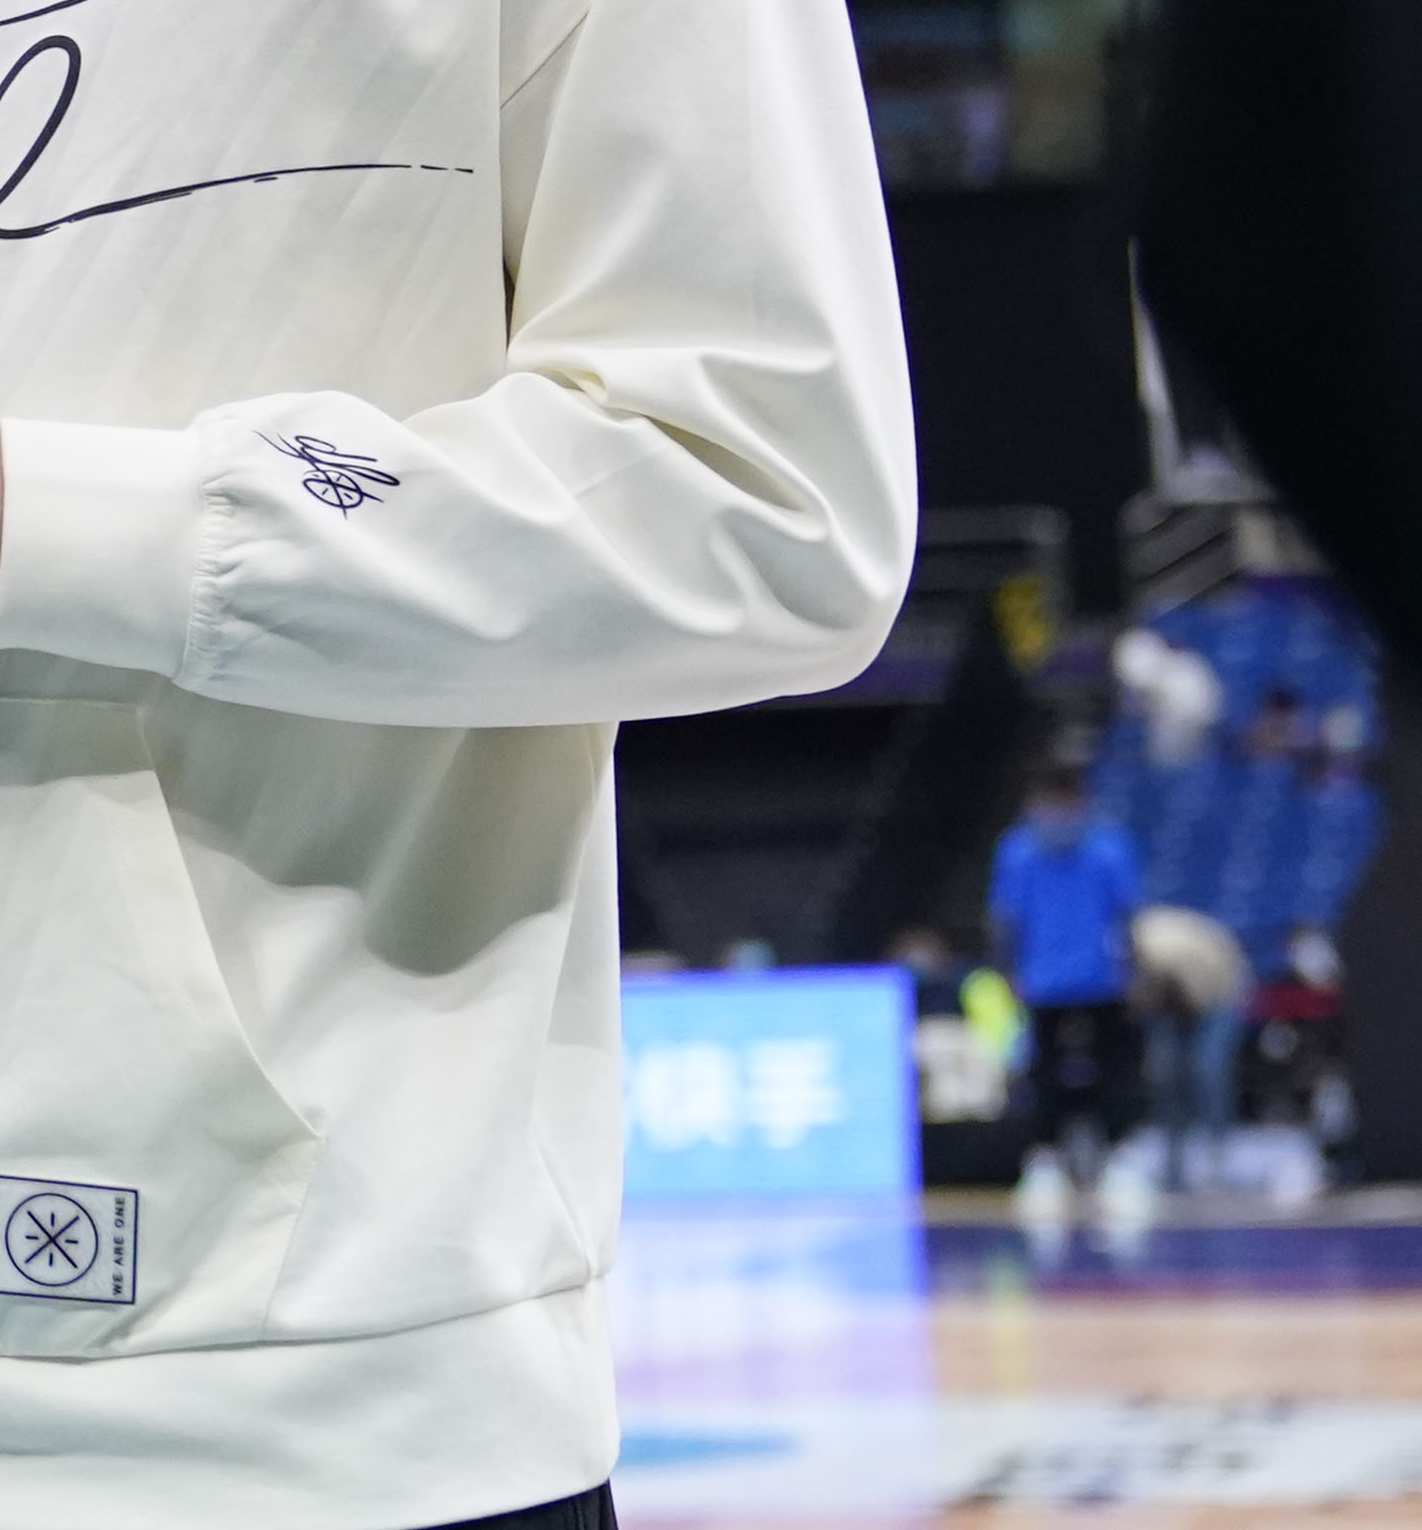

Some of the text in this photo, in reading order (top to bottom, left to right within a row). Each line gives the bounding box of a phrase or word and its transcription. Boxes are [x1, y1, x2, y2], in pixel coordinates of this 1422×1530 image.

[112, 1197, 125, 1296] WE ARE ONE
